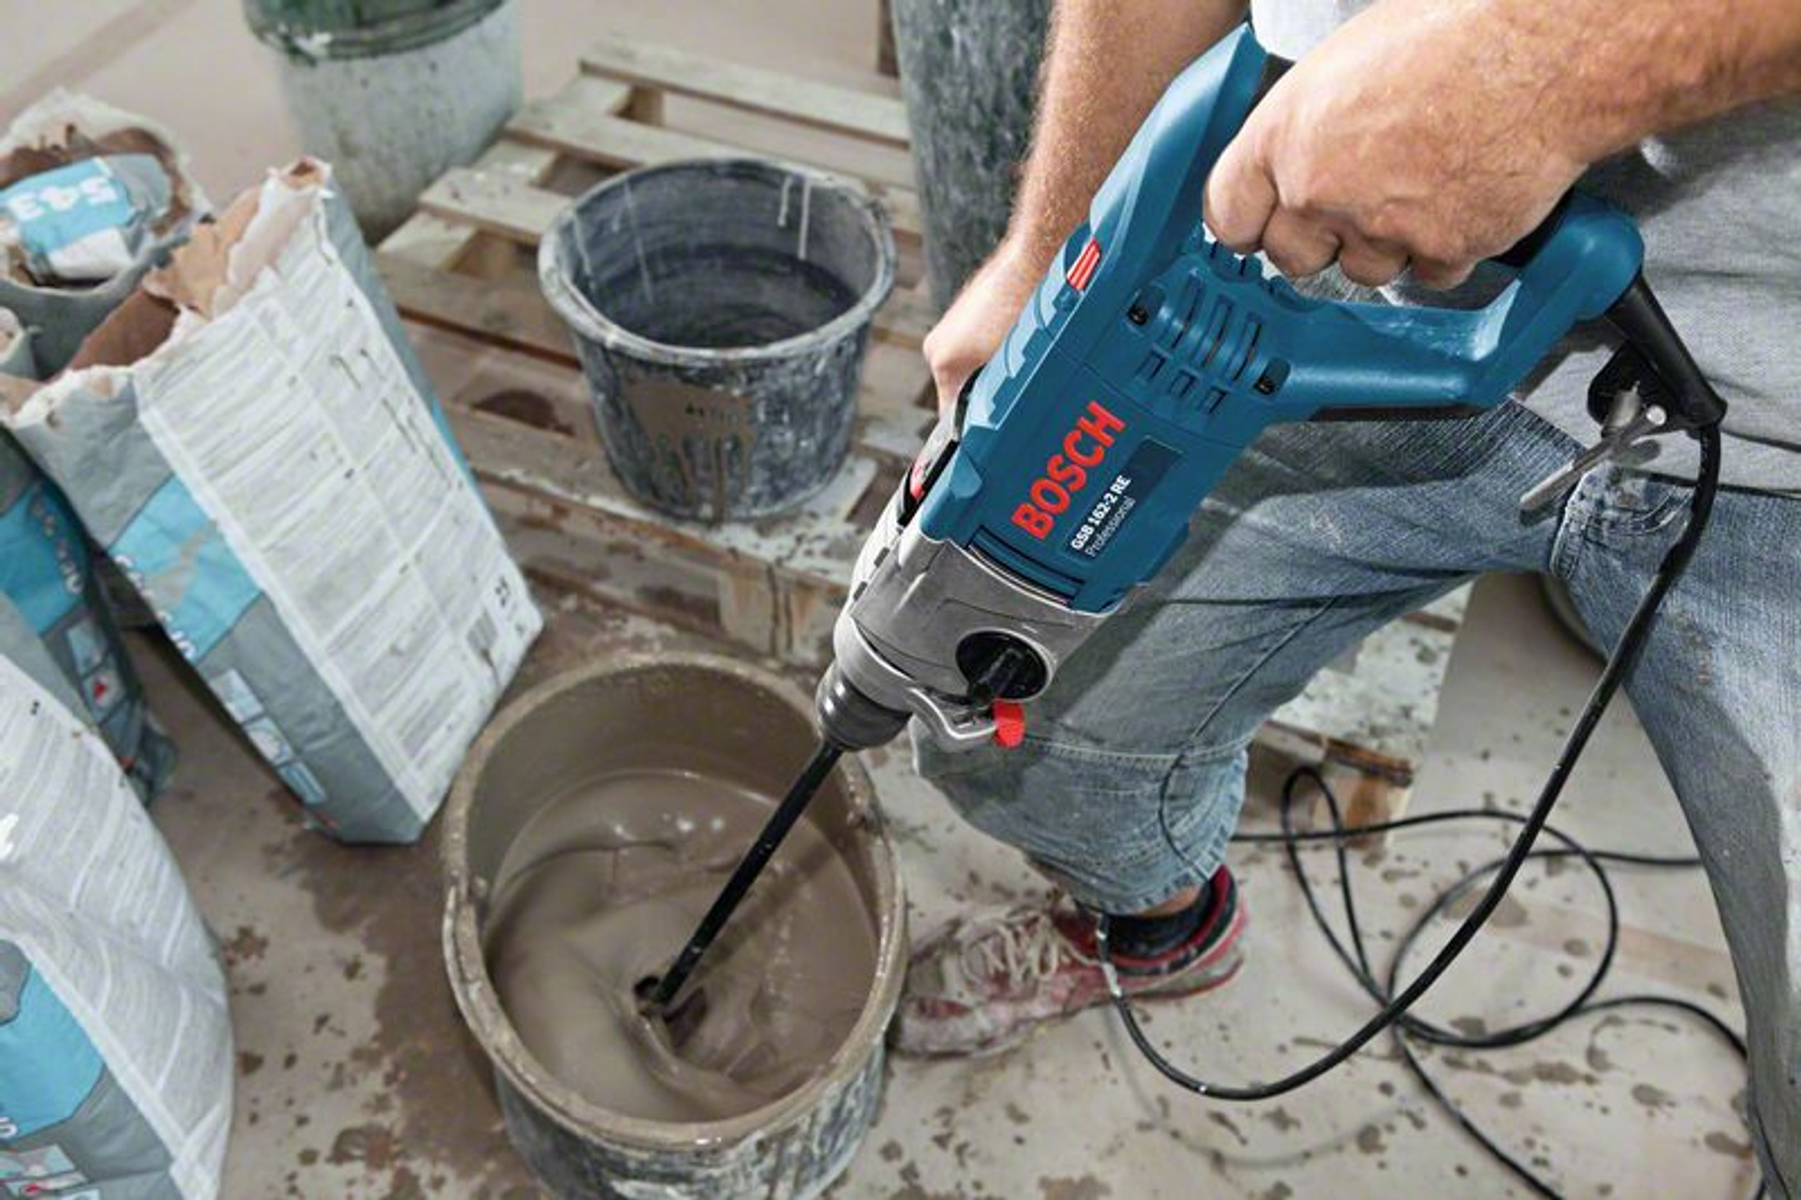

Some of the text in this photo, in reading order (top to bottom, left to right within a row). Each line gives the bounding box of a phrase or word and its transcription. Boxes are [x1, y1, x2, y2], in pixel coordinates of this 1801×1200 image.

[1011, 400, 1126, 540] BOSCH
[1071, 474, 1132, 550] GSB 162-2 RE
[1085, 495, 1136, 557] Professional
